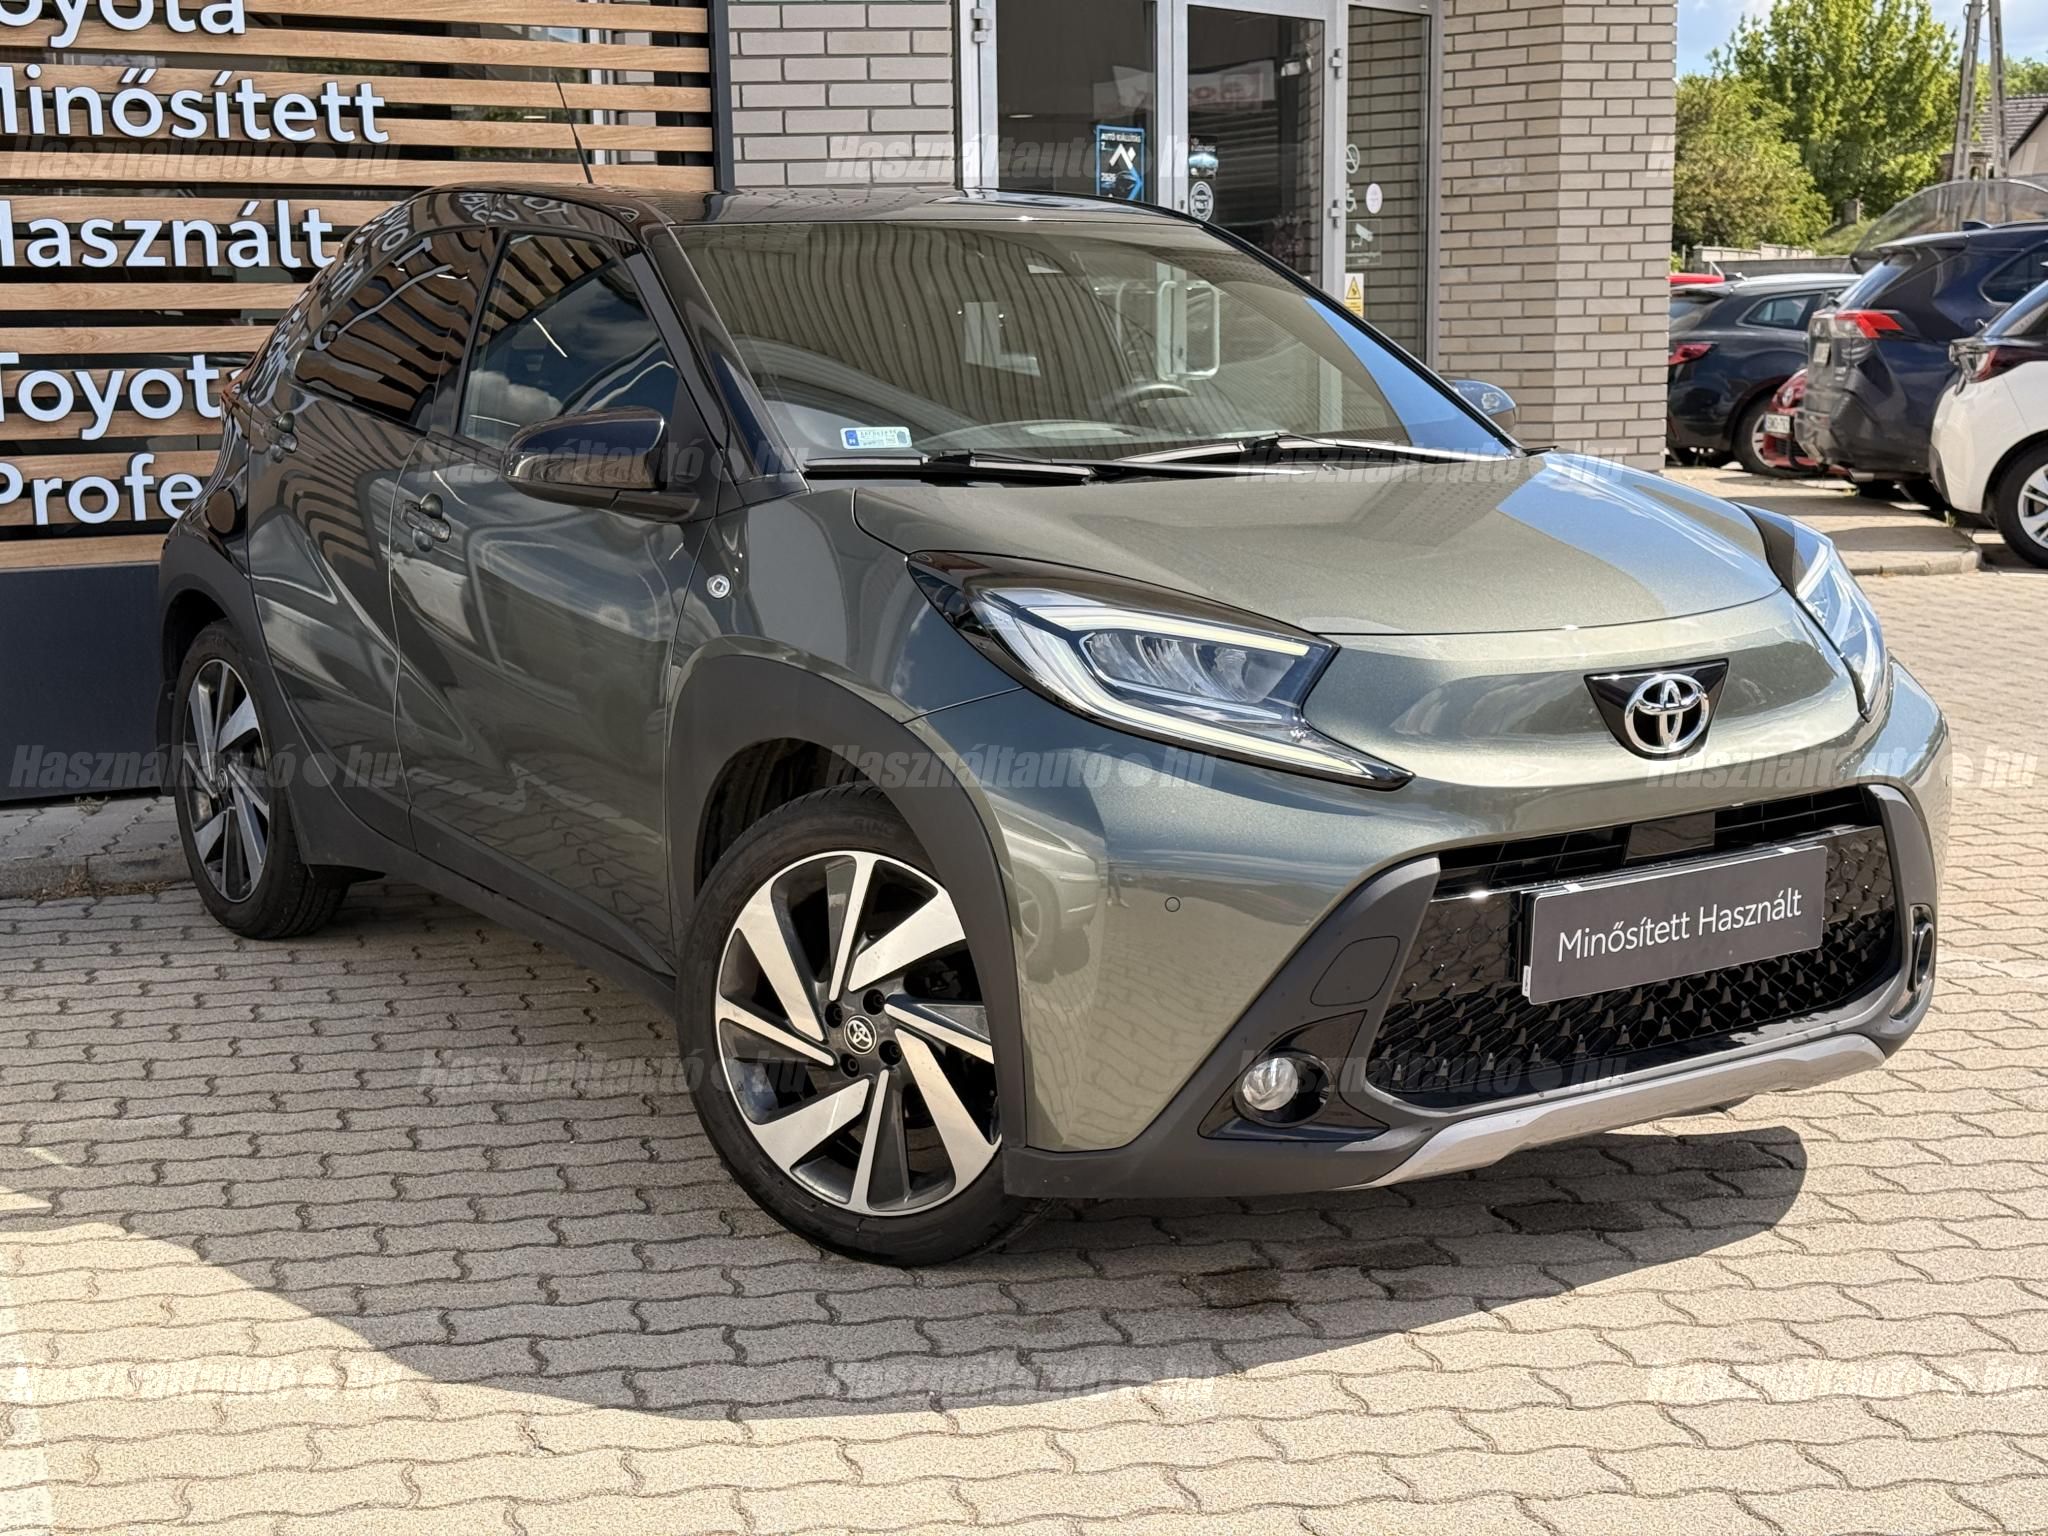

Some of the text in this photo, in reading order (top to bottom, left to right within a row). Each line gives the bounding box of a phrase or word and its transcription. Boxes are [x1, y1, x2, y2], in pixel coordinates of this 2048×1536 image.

[0, 0, 246, 49] oyota
[0, 63, 390, 144] inősített
[0, 199, 337, 268] asznált
[1558, 887, 1803, 962] Minősített Használt
